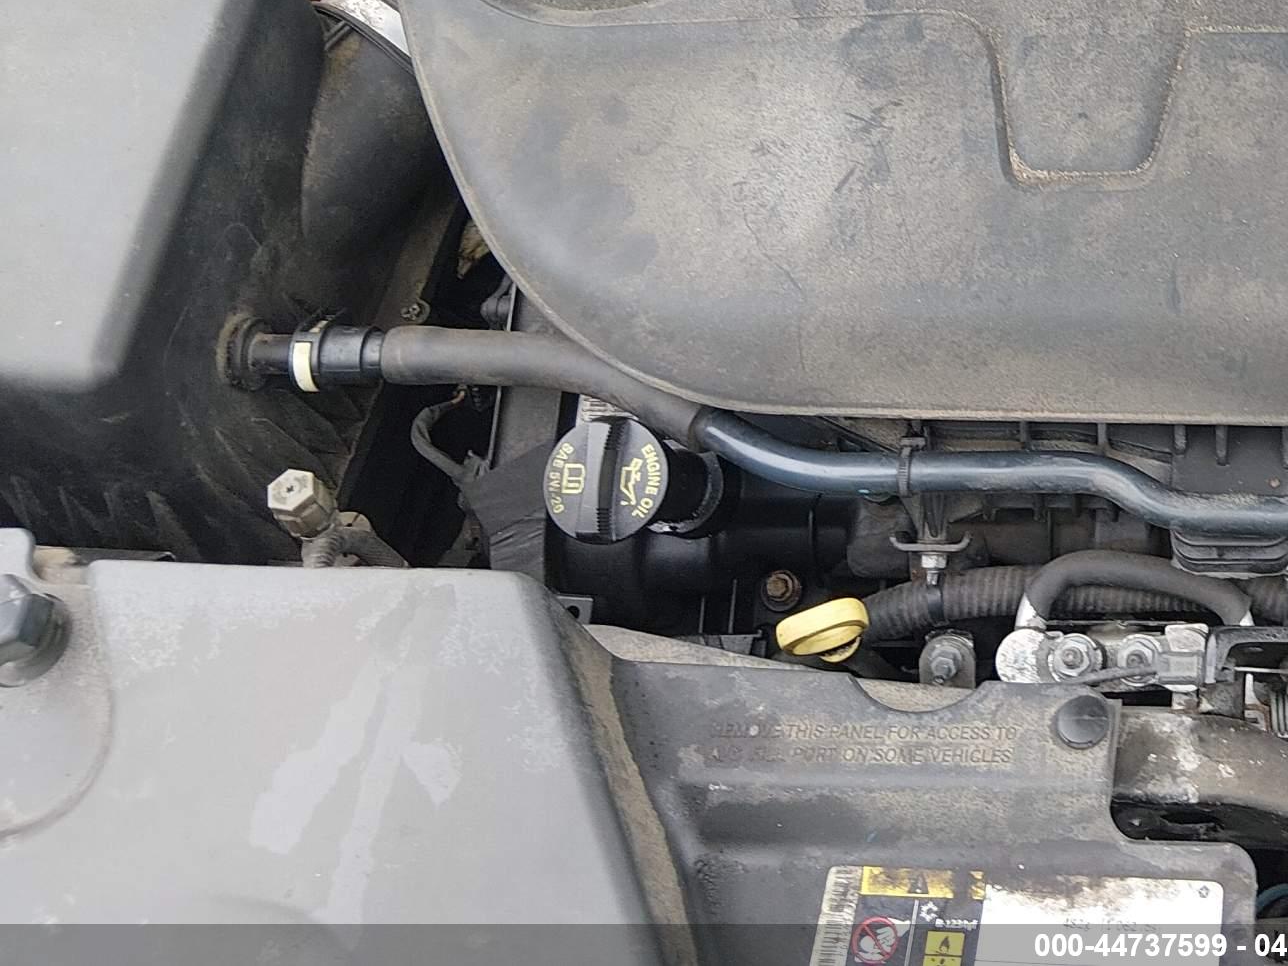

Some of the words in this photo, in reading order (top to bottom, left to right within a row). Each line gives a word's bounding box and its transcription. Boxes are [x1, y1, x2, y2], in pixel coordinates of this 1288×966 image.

[552, 442, 575, 468] SAE
[641, 443, 661, 495] ENGINE
[631, 497, 654, 519] OIL
[786, 723, 825, 740] THIS
[828, 724, 884, 740] PANEL
[887, 724, 924, 741] FOR
[927, 724, 995, 741] ACCESS
[997, 725, 1018, 741] TO
[795, 747, 837, 763] PORT
[841, 747, 869, 763] ON
[873, 747, 925, 764] SOME
[928, 747, 1013, 764] VEHICLES
